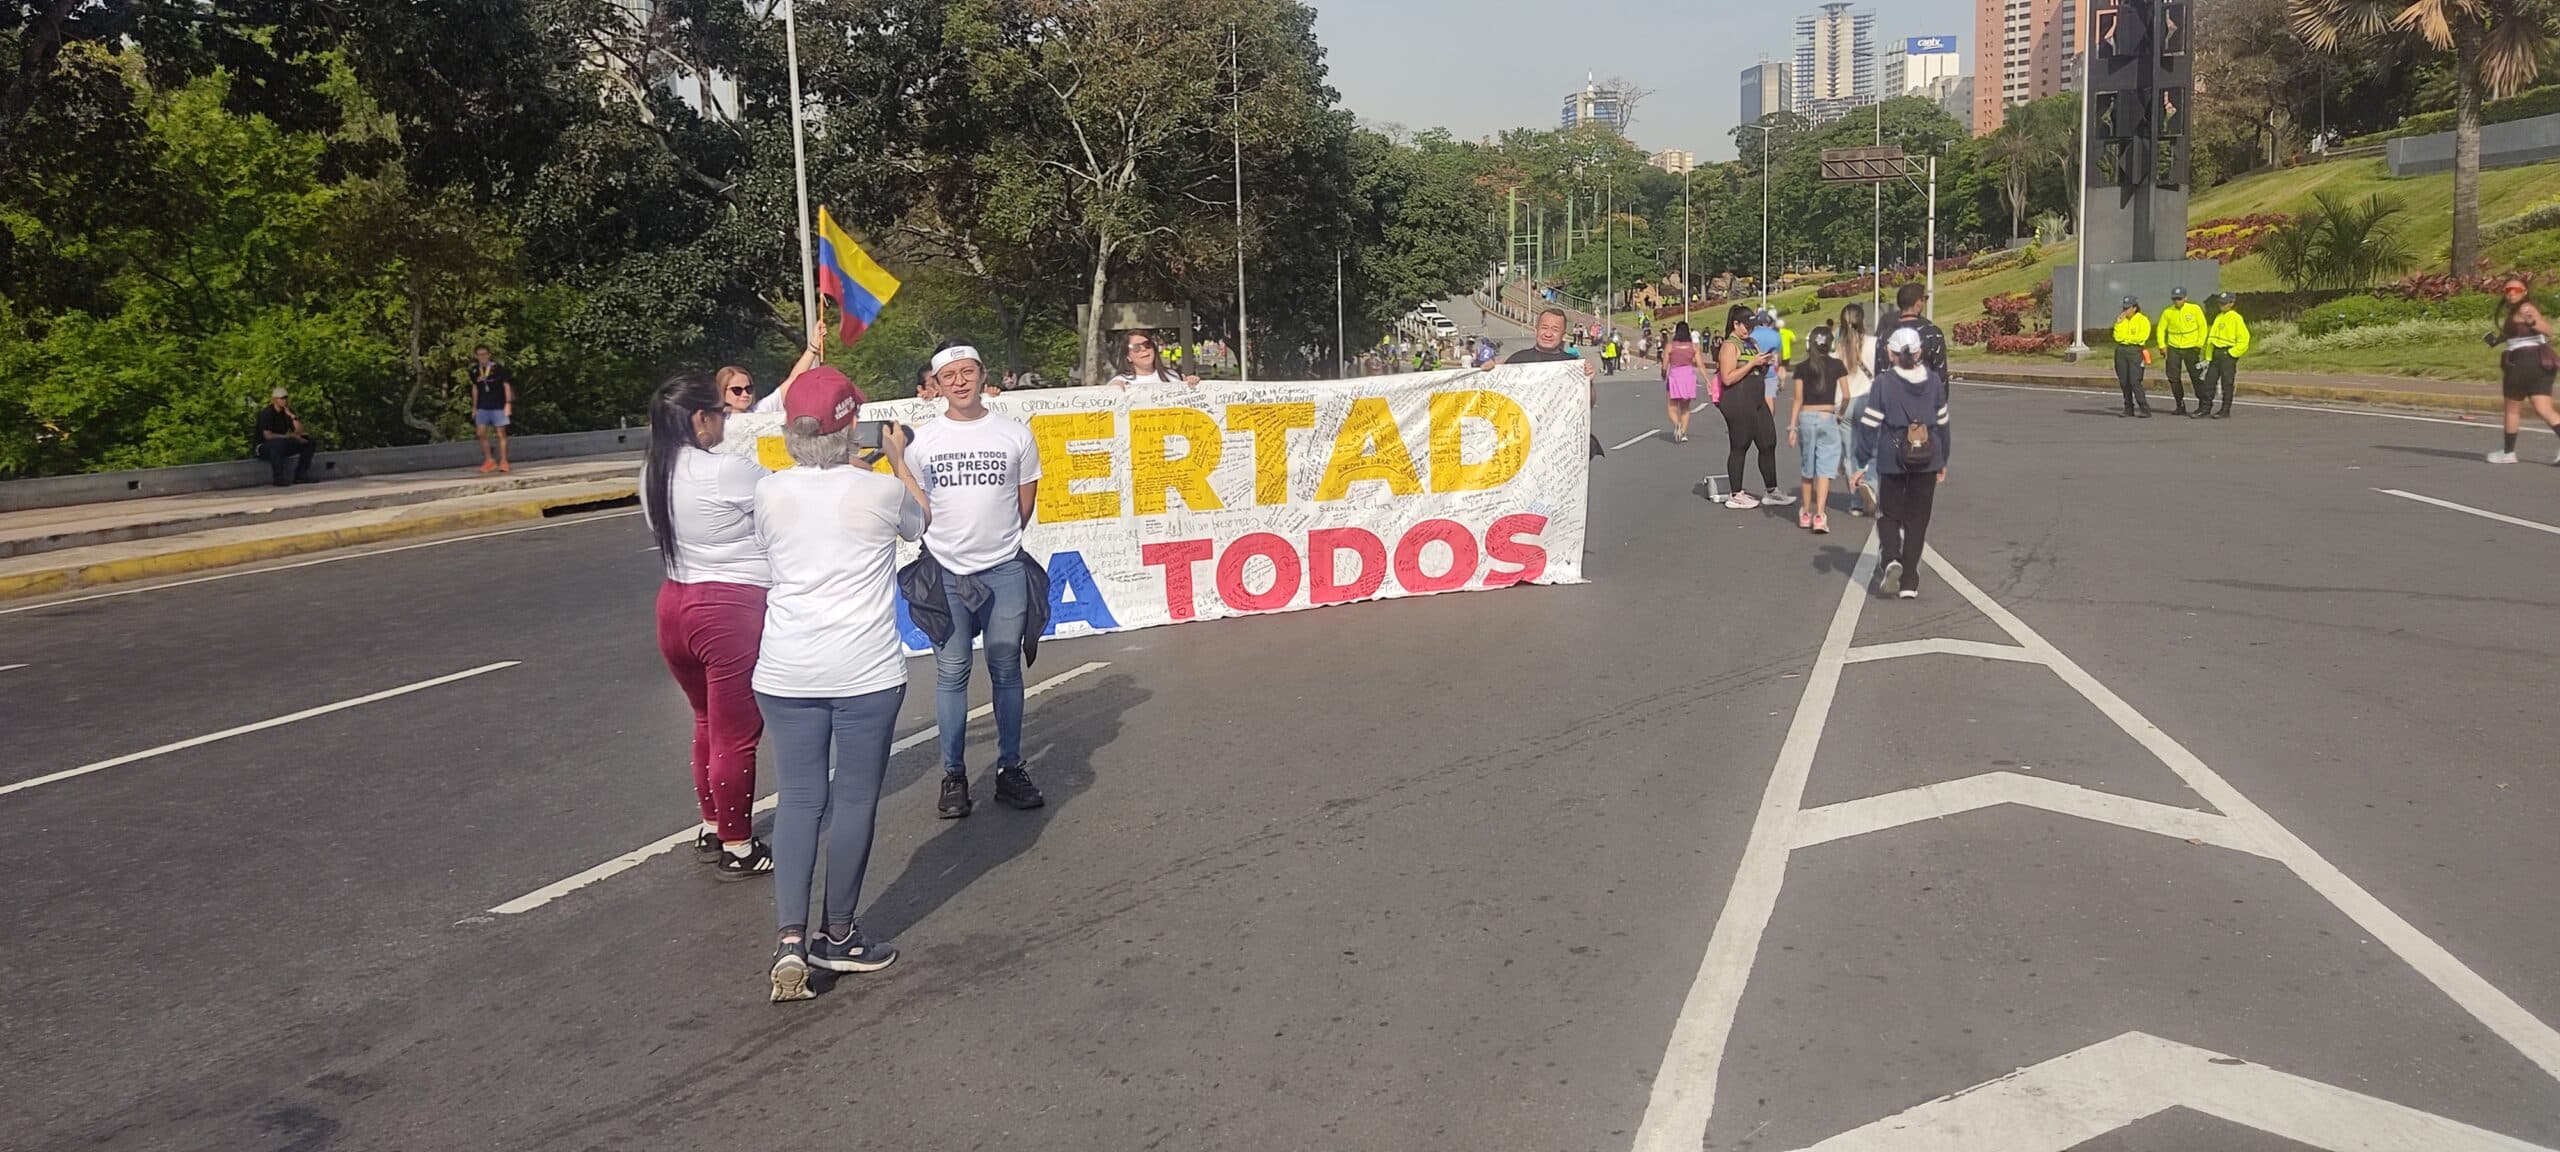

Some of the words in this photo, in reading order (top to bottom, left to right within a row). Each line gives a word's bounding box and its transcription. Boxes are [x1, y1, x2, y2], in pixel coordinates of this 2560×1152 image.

[757, 390, 1532, 524] ERTAD
[930, 452, 967, 463] LIBEREN
[969, 452, 976, 460] A
[978, 451, 1008, 460] TODOS
[930, 462, 953, 474] LOS
[957, 460, 1007, 471] PRESOS
[931, 471, 1006, 488] POLÍTICOS
[1142, 513, 1548, 620] TODOS
